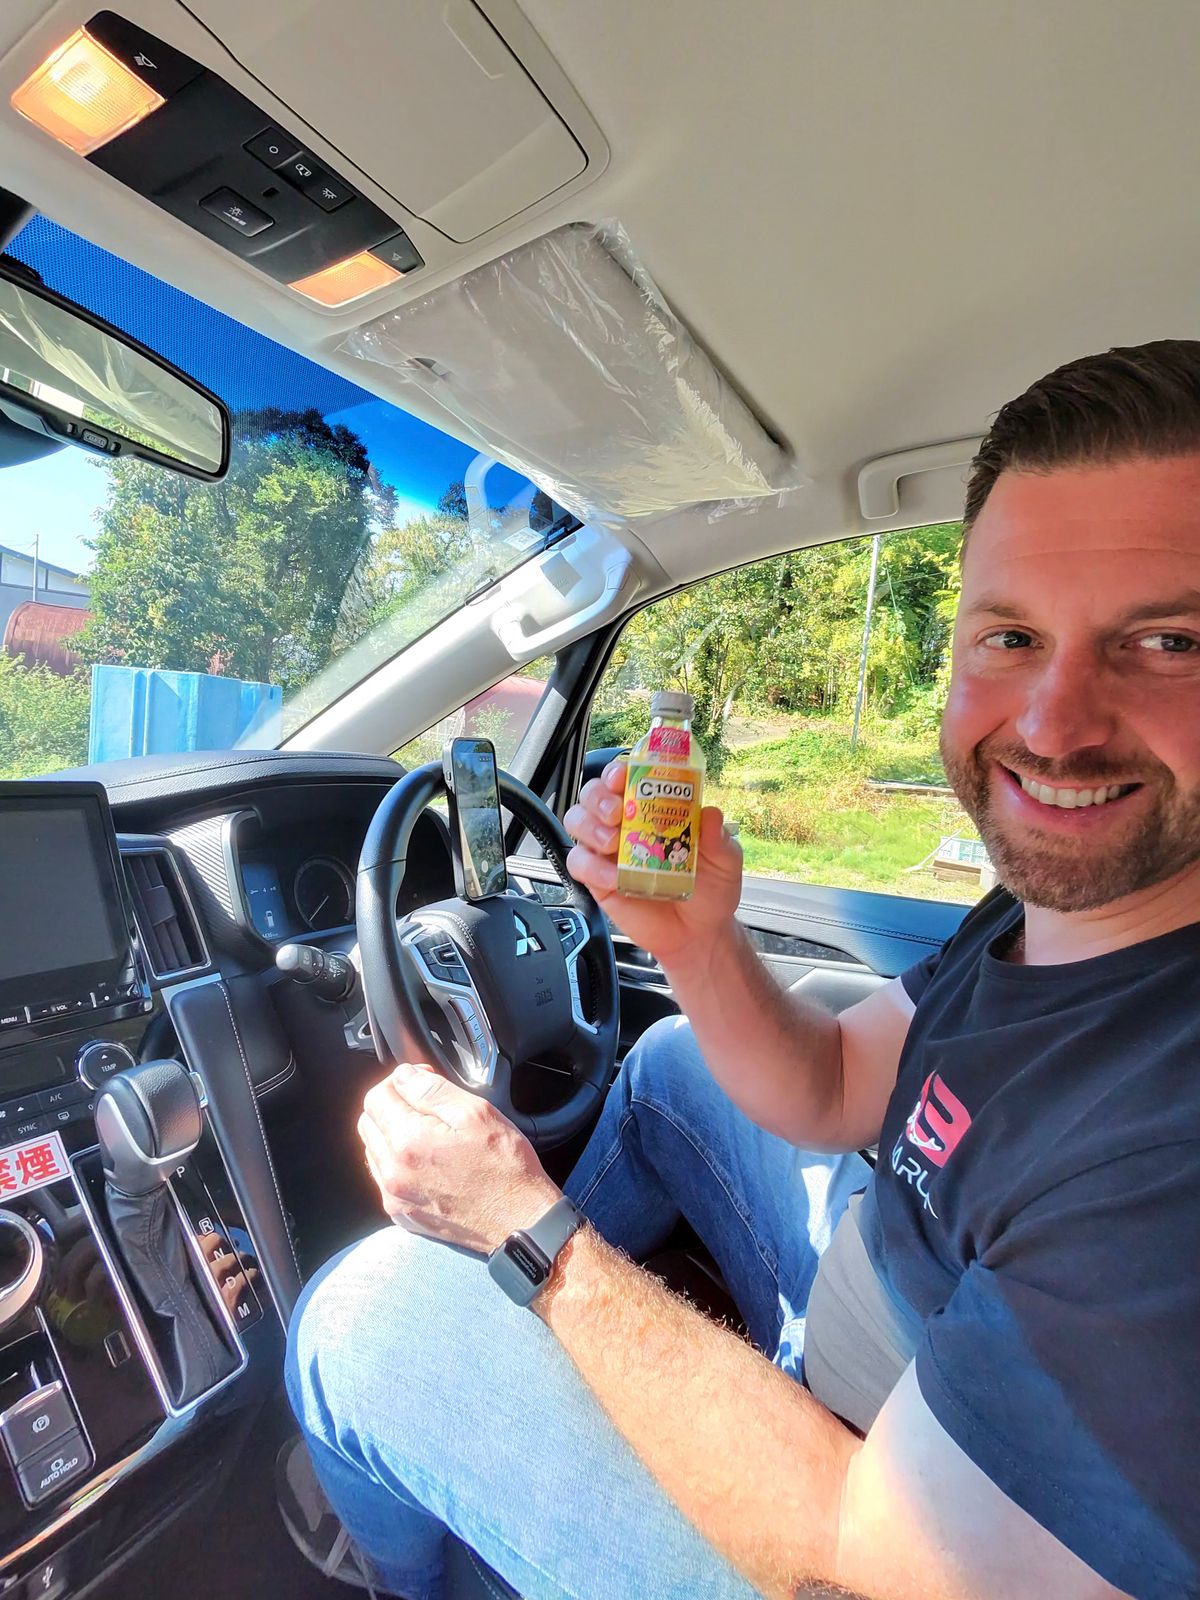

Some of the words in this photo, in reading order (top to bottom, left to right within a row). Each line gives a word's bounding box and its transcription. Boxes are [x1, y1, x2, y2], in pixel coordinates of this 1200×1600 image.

[641, 801, 689, 817] Vitamin
[643, 813, 686, 828] Lemon
[56, 1004, 68, 1012] VOL
[0, 1015, 18, 1024] MENU
[101, 1063, 117, 1073] TEMP
[50, 1093, 63, 1102] A/C
[17, 1122, 38, 1135] SYNC
[176, 1165, 186, 1178] P
[201, 1219, 213, 1233] R
[213, 1247, 225, 1260] N
[225, 1276, 237, 1289] D
[237, 1302, 251, 1319] M
[40, 1470, 60, 1489] AUTO
[60, 1457, 79, 1475] HOLD
